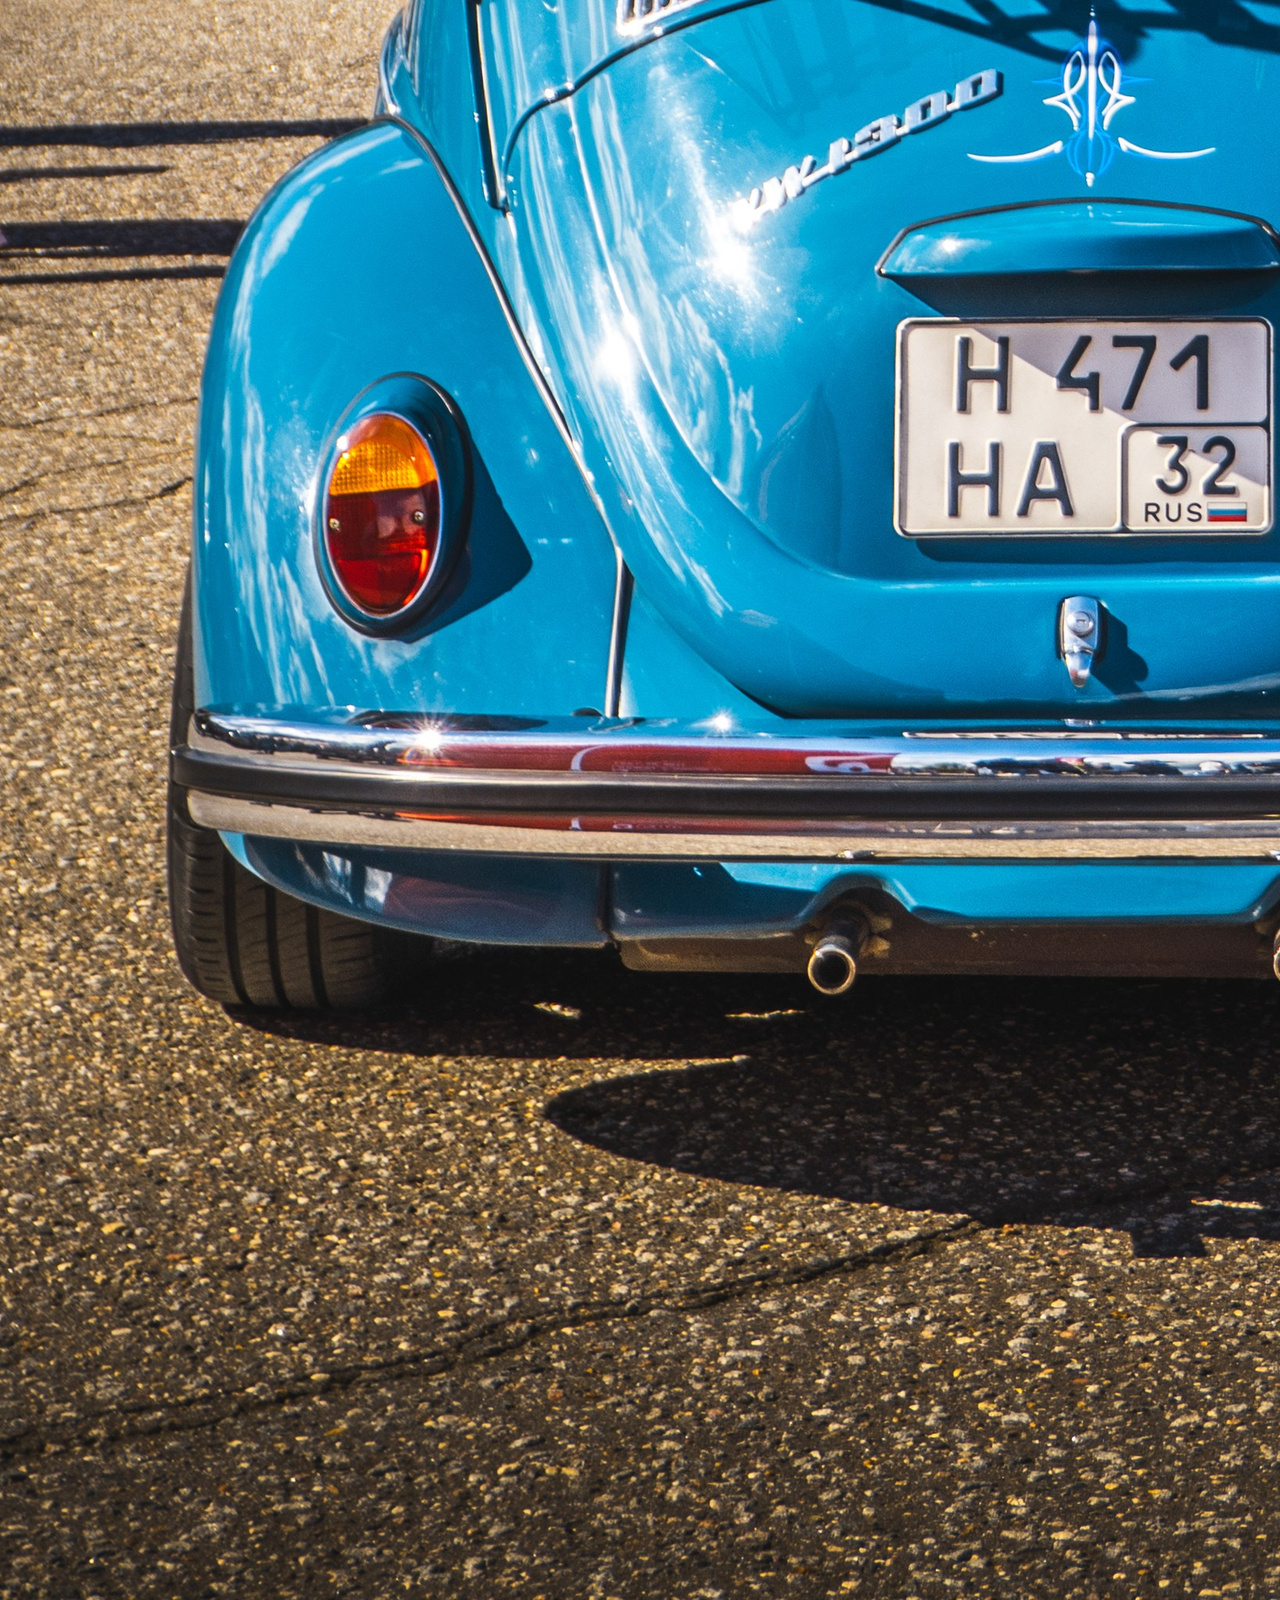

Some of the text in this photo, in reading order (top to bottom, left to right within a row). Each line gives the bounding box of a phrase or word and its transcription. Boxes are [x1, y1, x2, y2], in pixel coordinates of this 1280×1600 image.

[1055, 334, 1210, 412] 471
[1155, 434, 1238, 497] 32
[1144, 501, 1202, 523] RUS
